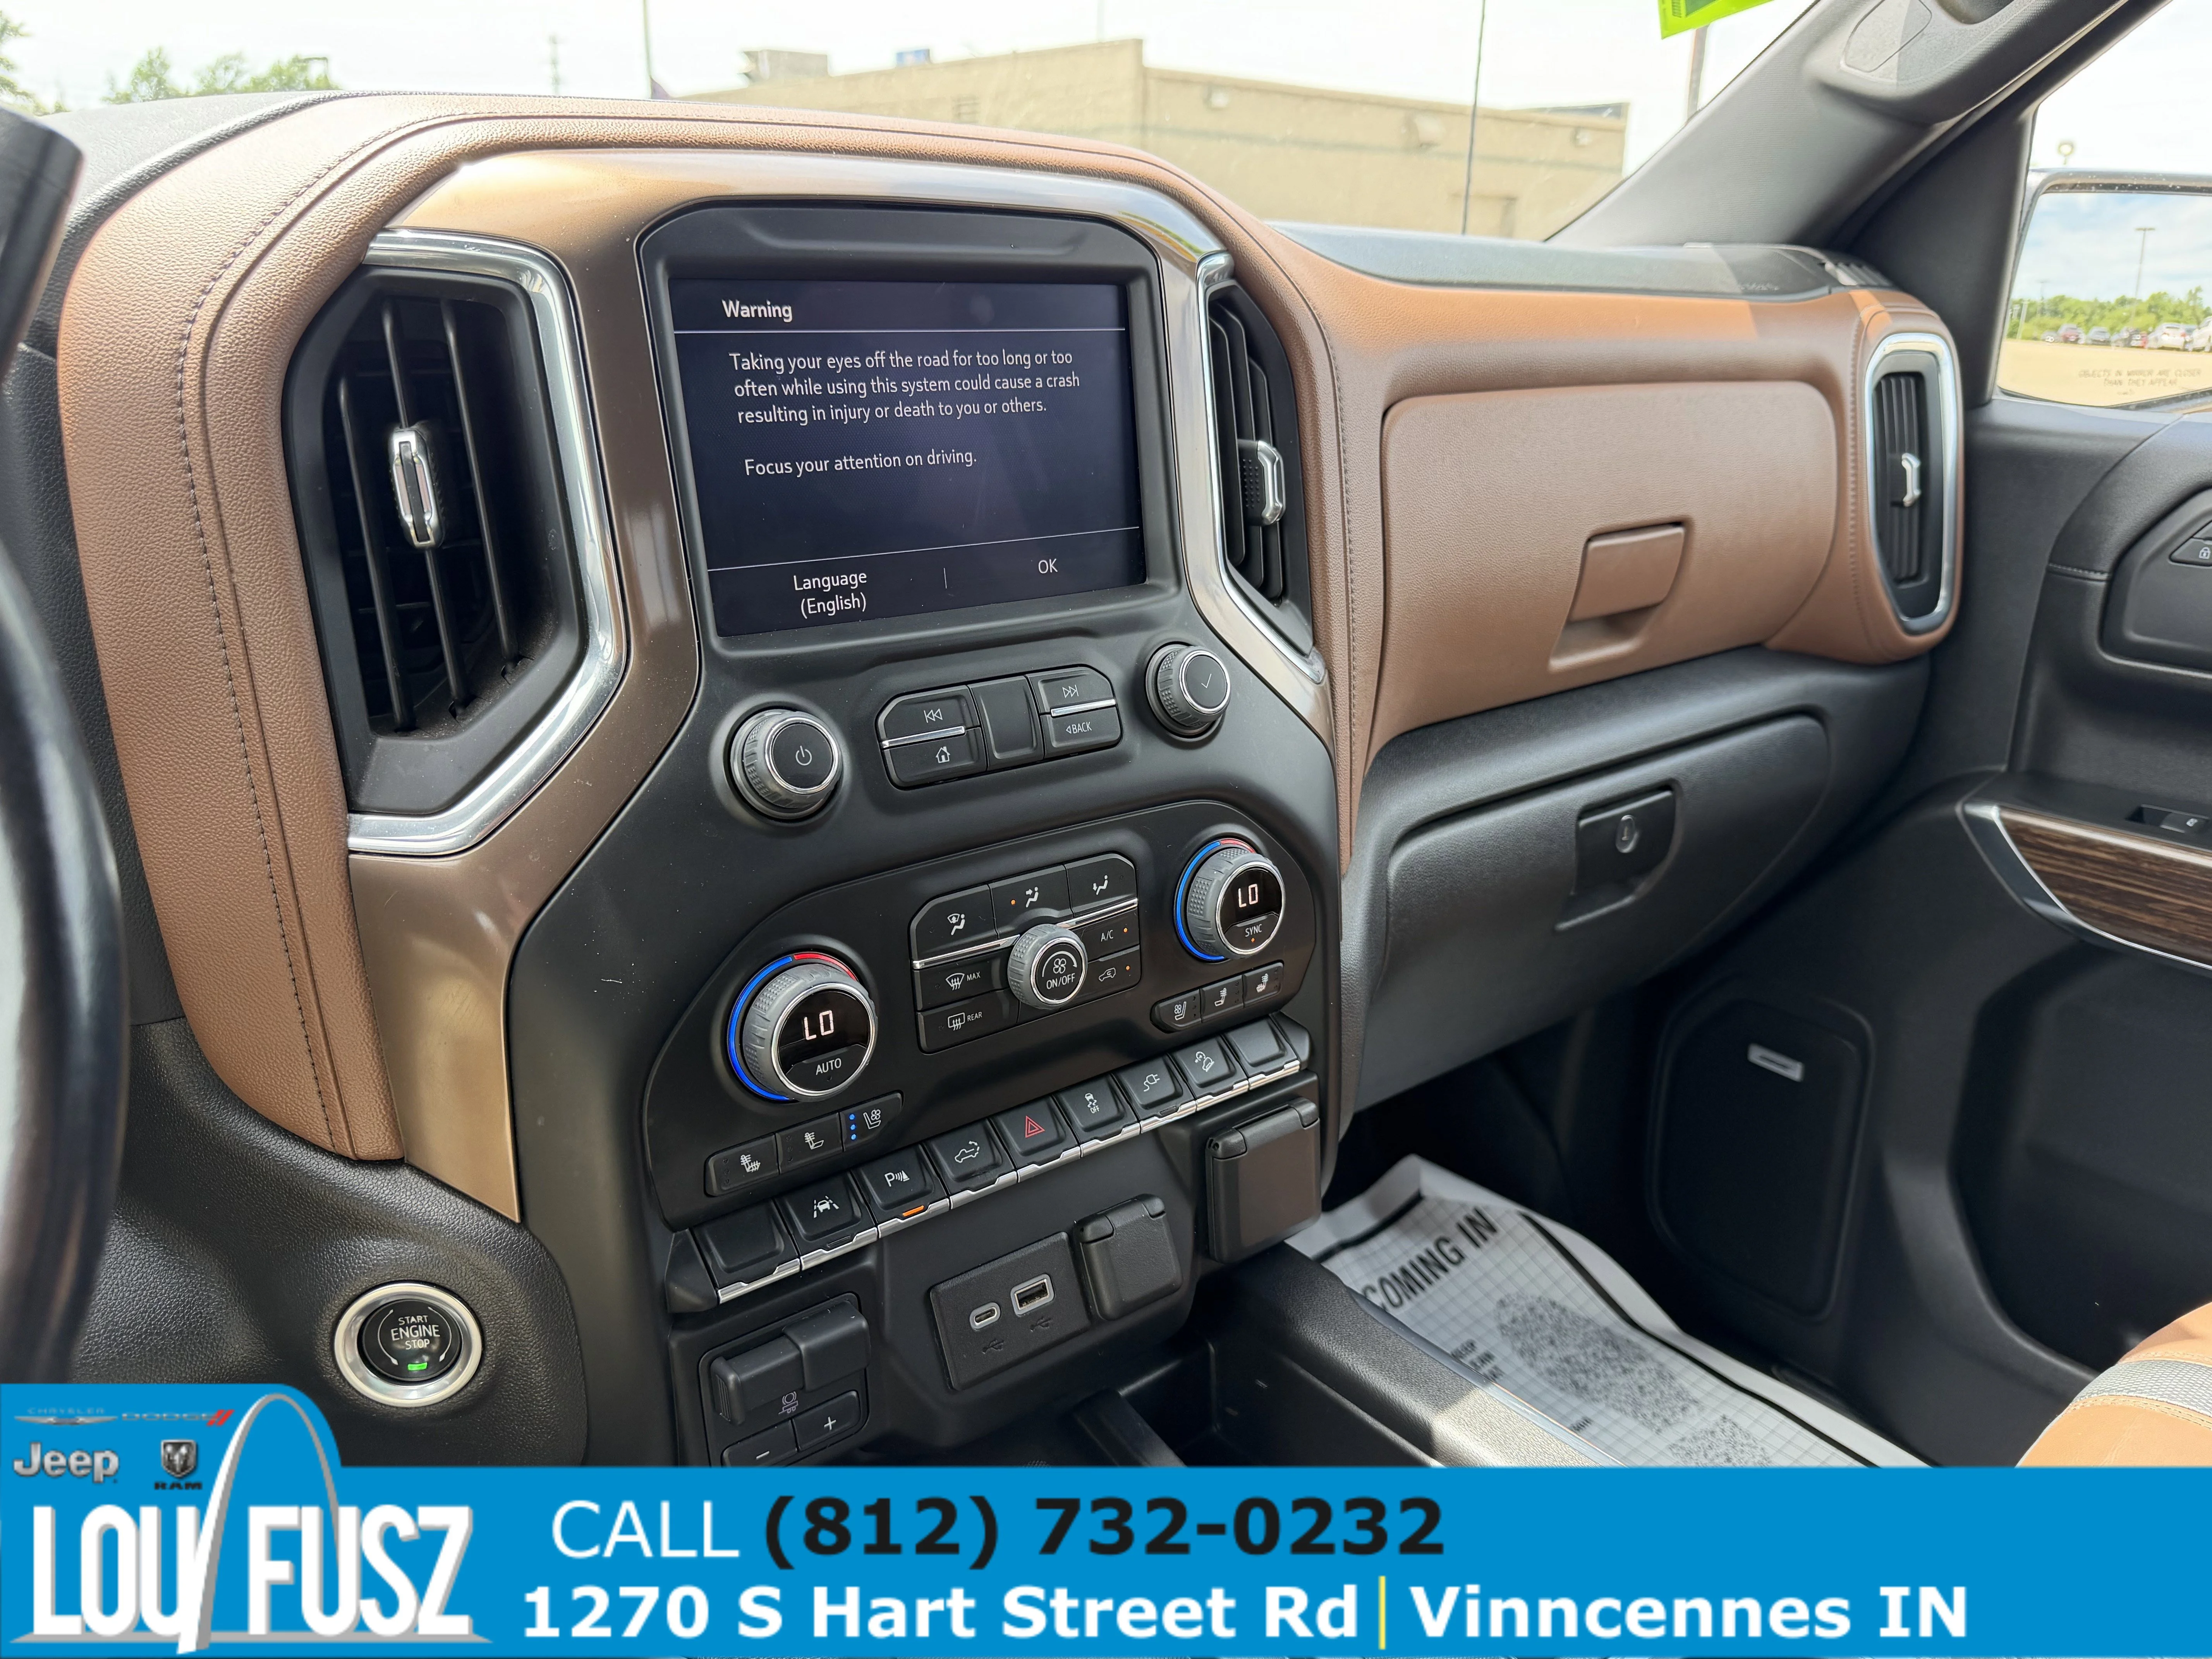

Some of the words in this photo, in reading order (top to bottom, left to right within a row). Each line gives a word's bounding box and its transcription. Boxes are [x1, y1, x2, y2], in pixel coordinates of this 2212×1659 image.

[722, 300, 793, 323] Warning
[729, 352, 784, 374] Taking
[787, 357, 822, 374] your
[827, 356, 861, 373] eyes
[865, 350, 886, 368] off
[889, 350, 913, 368] the
[917, 349, 949, 367] road
[953, 350, 972, 366] for
[976, 351, 999, 366] too
[1002, 349, 1031, 369] long
[1035, 354, 1048, 364] or
[1051, 350, 1072, 364] too
[734, 379, 777, 397] often
[781, 377, 822, 395] while
[827, 378, 867, 398] using
[870, 376, 898, 393] this
[902, 377, 950, 397] system
[955, 373, 991, 391] could
[994, 378, 1031, 389] cause
[1036, 378, 1042, 388] a
[1046, 371, 1080, 388] crash
[738, 404, 808, 426] resulting
[812, 405, 826, 421] in
[830, 404, 870, 424] injury
[875, 407, 890, 418] or
[894, 399, 934, 417] death
[938, 402, 953, 416] to
[956, 404, 980, 419] you
[984, 403, 998, 414] or
[1002, 397, 1046, 413] others.
[745, 459, 793, 476] Focus
[795, 460, 830, 477] your
[835, 453, 901, 470] attention
[905, 455, 923, 466] on
[927, 448, 977, 467] driving.
[1038, 558, 1058, 574] OK
[793, 573, 867, 592] Language
[801, 592, 866, 619] (English)
[1072, 721, 1092, 734] BACK
[1101, 930, 1113, 942] A/C
[1245, 924, 1262, 937] SYNC
[967, 971, 981, 981] MAX
[1046, 973, 1075, 989] ON/OFF
[967, 1012, 982, 1022] REAR
[816, 1058, 842, 1075] AUTO
[1090, 1105, 1099, 1114] OFF
[1456, 1206, 1498, 1249] IN
[398, 1315, 428, 1325] START
[390, 1324, 441, 1341] ENGINE
[405, 1339, 430, 1350] STOP
